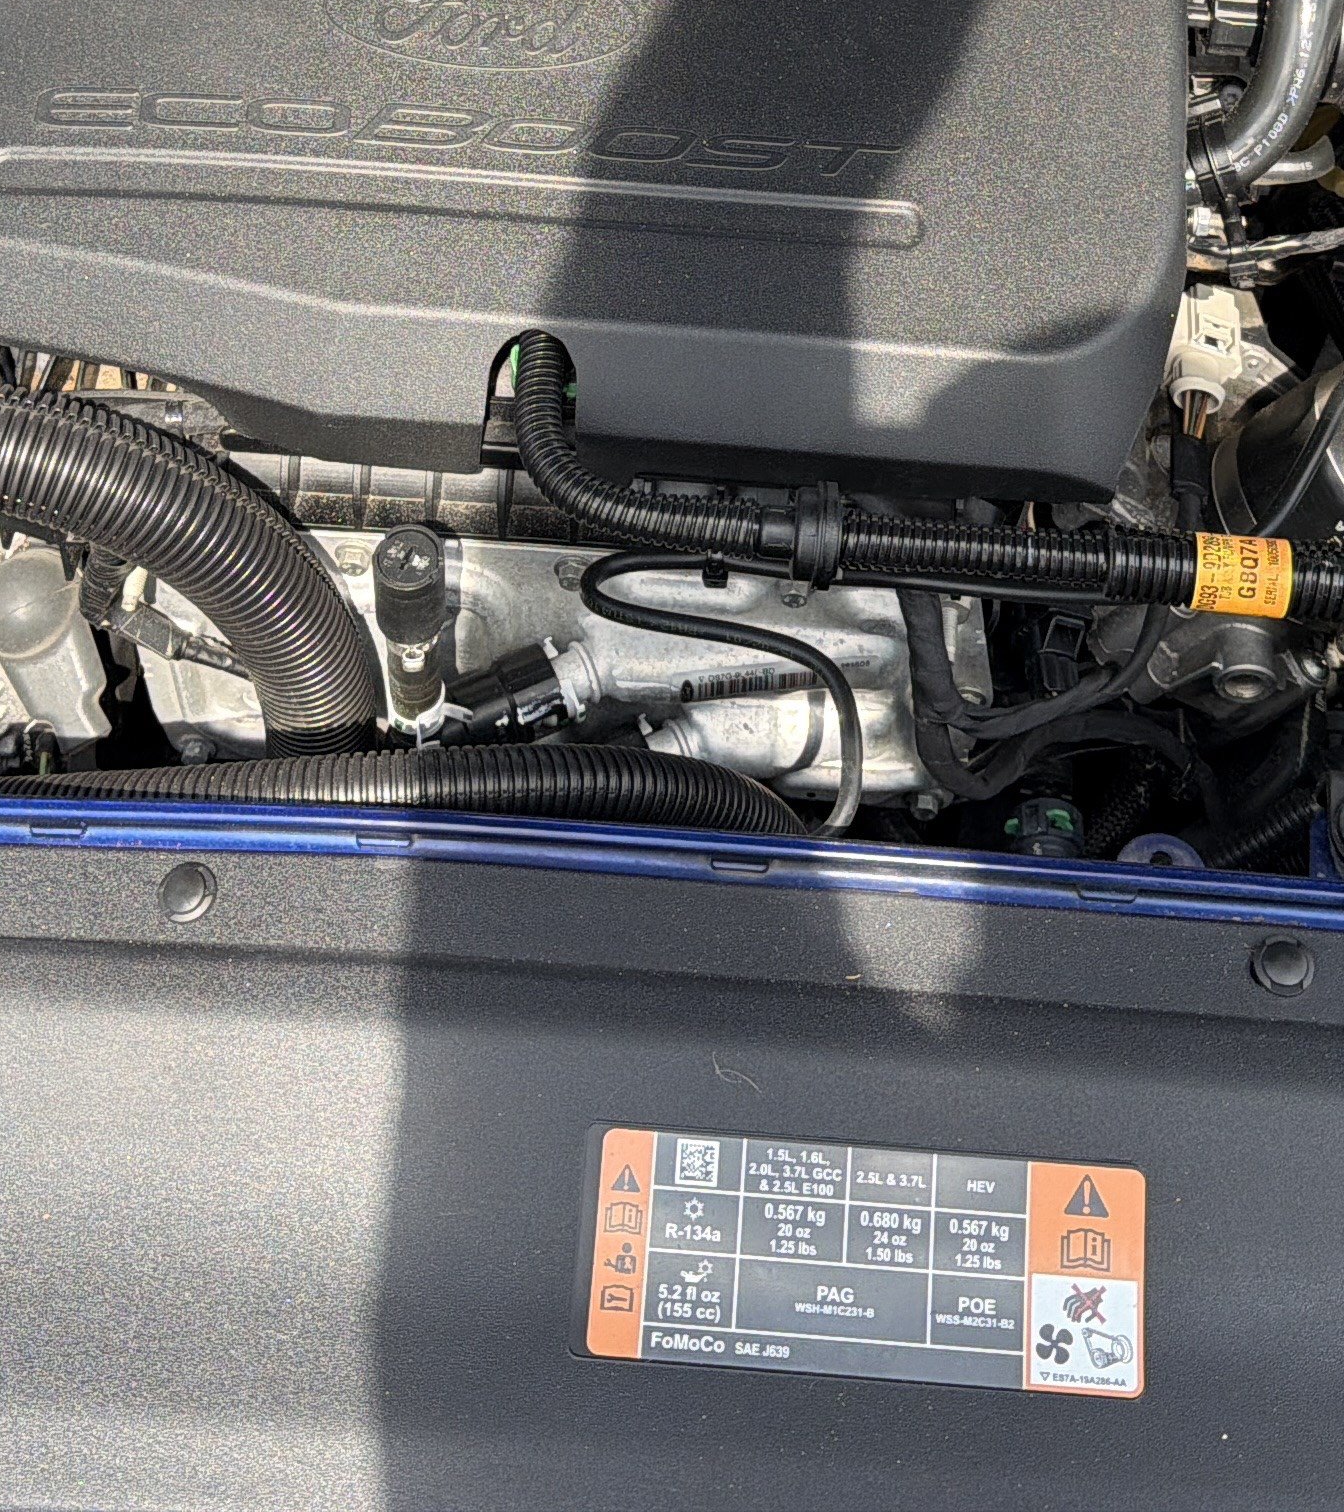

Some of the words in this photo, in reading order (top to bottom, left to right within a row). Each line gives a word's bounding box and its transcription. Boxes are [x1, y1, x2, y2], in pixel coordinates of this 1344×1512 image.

[767, 1147, 796, 1163] 1.5L,
[800, 1149, 830, 1166] 1.6L,
[749, 1163, 779, 1178] 2.0L,
[783, 1165, 809, 1179] 3.7L
[813, 1168, 842, 1181] GCC
[856, 1170, 883, 1185] 2.5L
[886, 1173, 896, 1186] &
[899, 1174, 927, 1188] 3.7L
[759, 1179, 769, 1191] &
[773, 1180, 800, 1194] 2.5L
[802, 1182, 834, 1197] E100
[967, 1180, 995, 1194] HEV
[764, 1203, 805, 1221] 0.567
[807, 1207, 826, 1227] kg
[860, 1210, 899, 1229] 0.680
[903, 1214, 922, 1234] kg
[665, 1223, 721, 1242] R-134a
[777, 1223, 793, 1236] 20
[795, 1227, 811, 1239] oz
[873, 1231, 889, 1244] 24
[891, 1235, 907, 1246] oz
[949, 1219, 988, 1237] 0.567
[991, 1223, 1009, 1242] kg
[770, 1240, 795, 1254] 1.25
[798, 1242, 817, 1256] lbs
[962, 1238, 977, 1252] 20
[980, 1242, 995, 1254] oz
[865, 1247, 891, 1262] 1.50
[894, 1250, 913, 1264] lbs
[955, 1254, 980, 1268] 1.25
[983, 1257, 1002, 1271] lbs
[658, 1284, 682, 1300] 5.2
[686, 1285, 697, 1301] fl
[701, 1289, 721, 1303] oz
[817, 1285, 855, 1304] PAG
[657, 1301, 692, 1319] (155
[696, 1305, 721, 1323] cc)
[958, 1296, 997, 1316] POE
[650, 1331, 725, 1353] FoMoCo
[734, 1342, 760, 1357] SAE
[762, 1343, 790, 1360] J639
